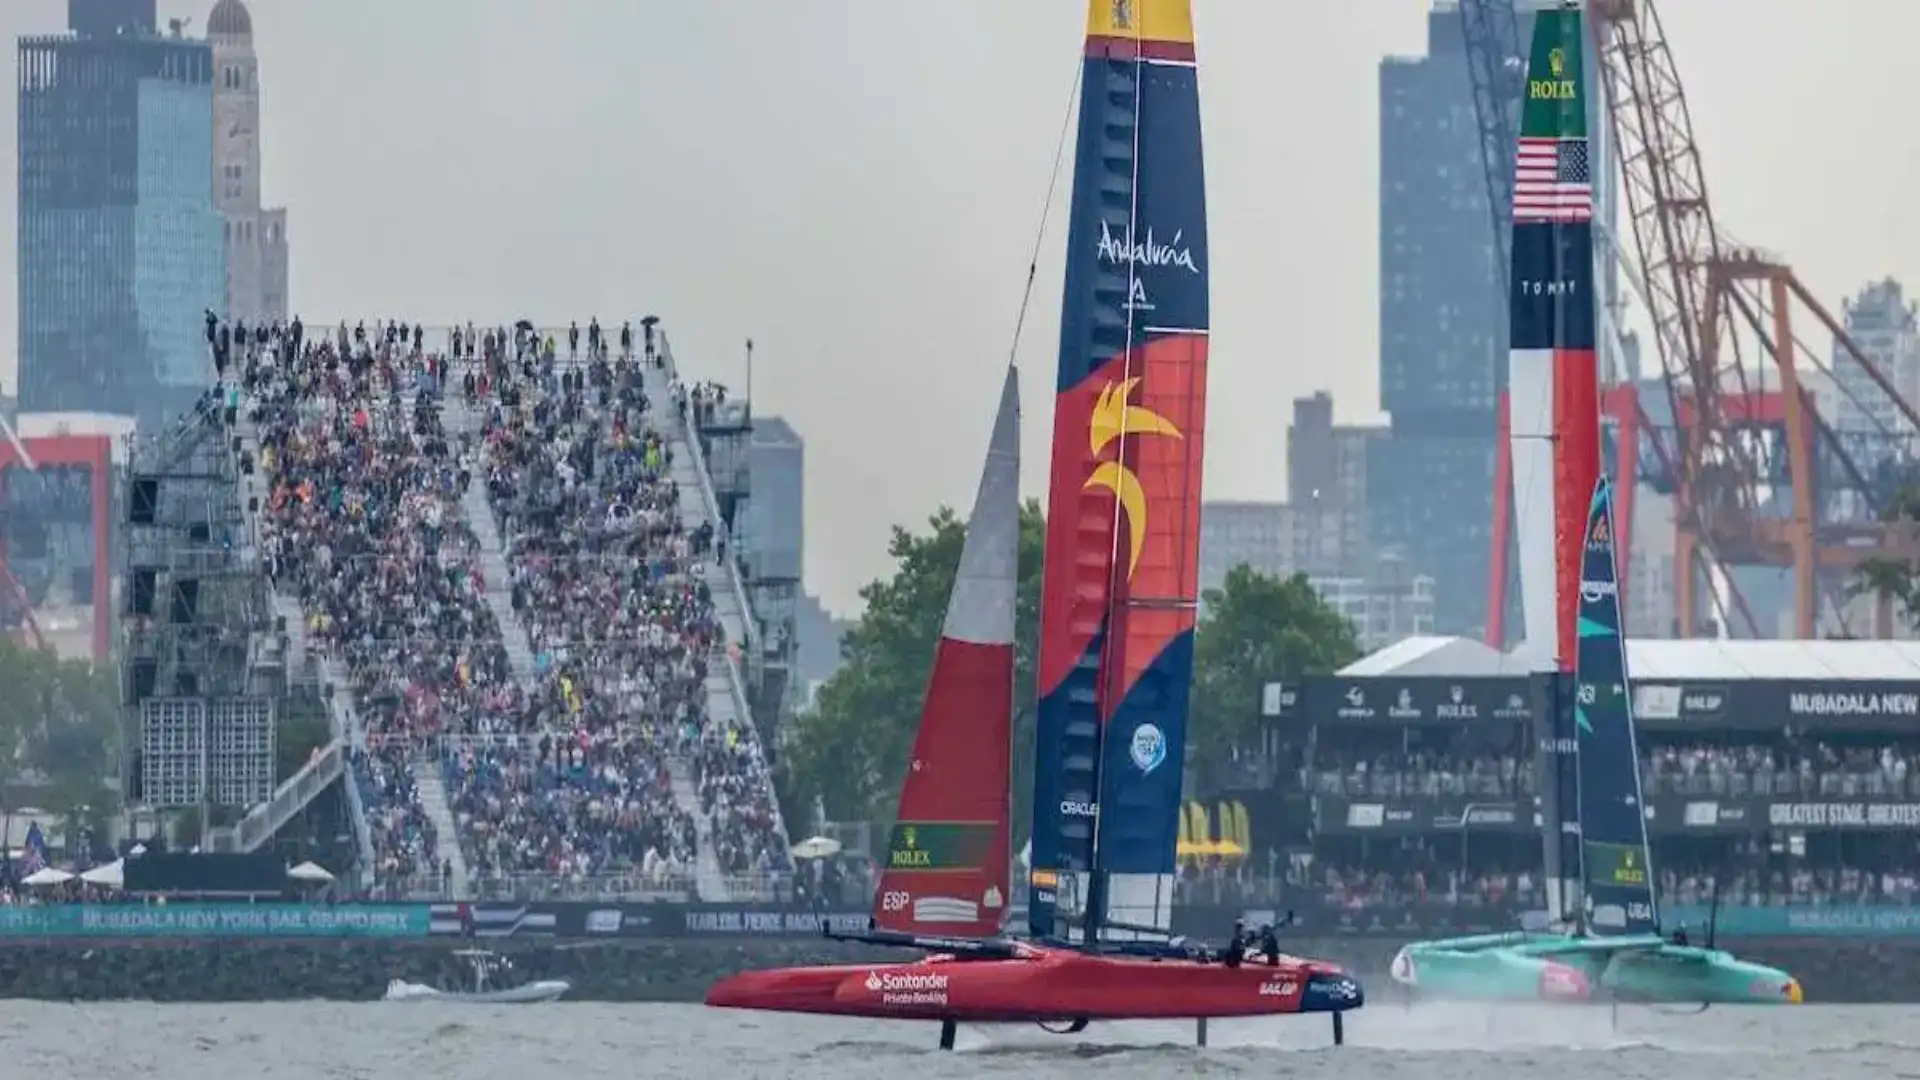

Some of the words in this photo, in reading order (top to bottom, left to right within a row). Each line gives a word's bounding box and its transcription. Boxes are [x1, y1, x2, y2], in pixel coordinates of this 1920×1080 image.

[1530, 80, 1575, 98] ROLEX
[1097, 218, 1199, 273] Andalucía
[1790, 693, 1880, 714] MUBADALA
[1881, 694, 1918, 714] NEW
[892, 850, 931, 866] ROLEX
[883, 890, 909, 911] ESP
[82, 909, 176, 929] MUBADALA
[882, 972, 948, 989] Santander
